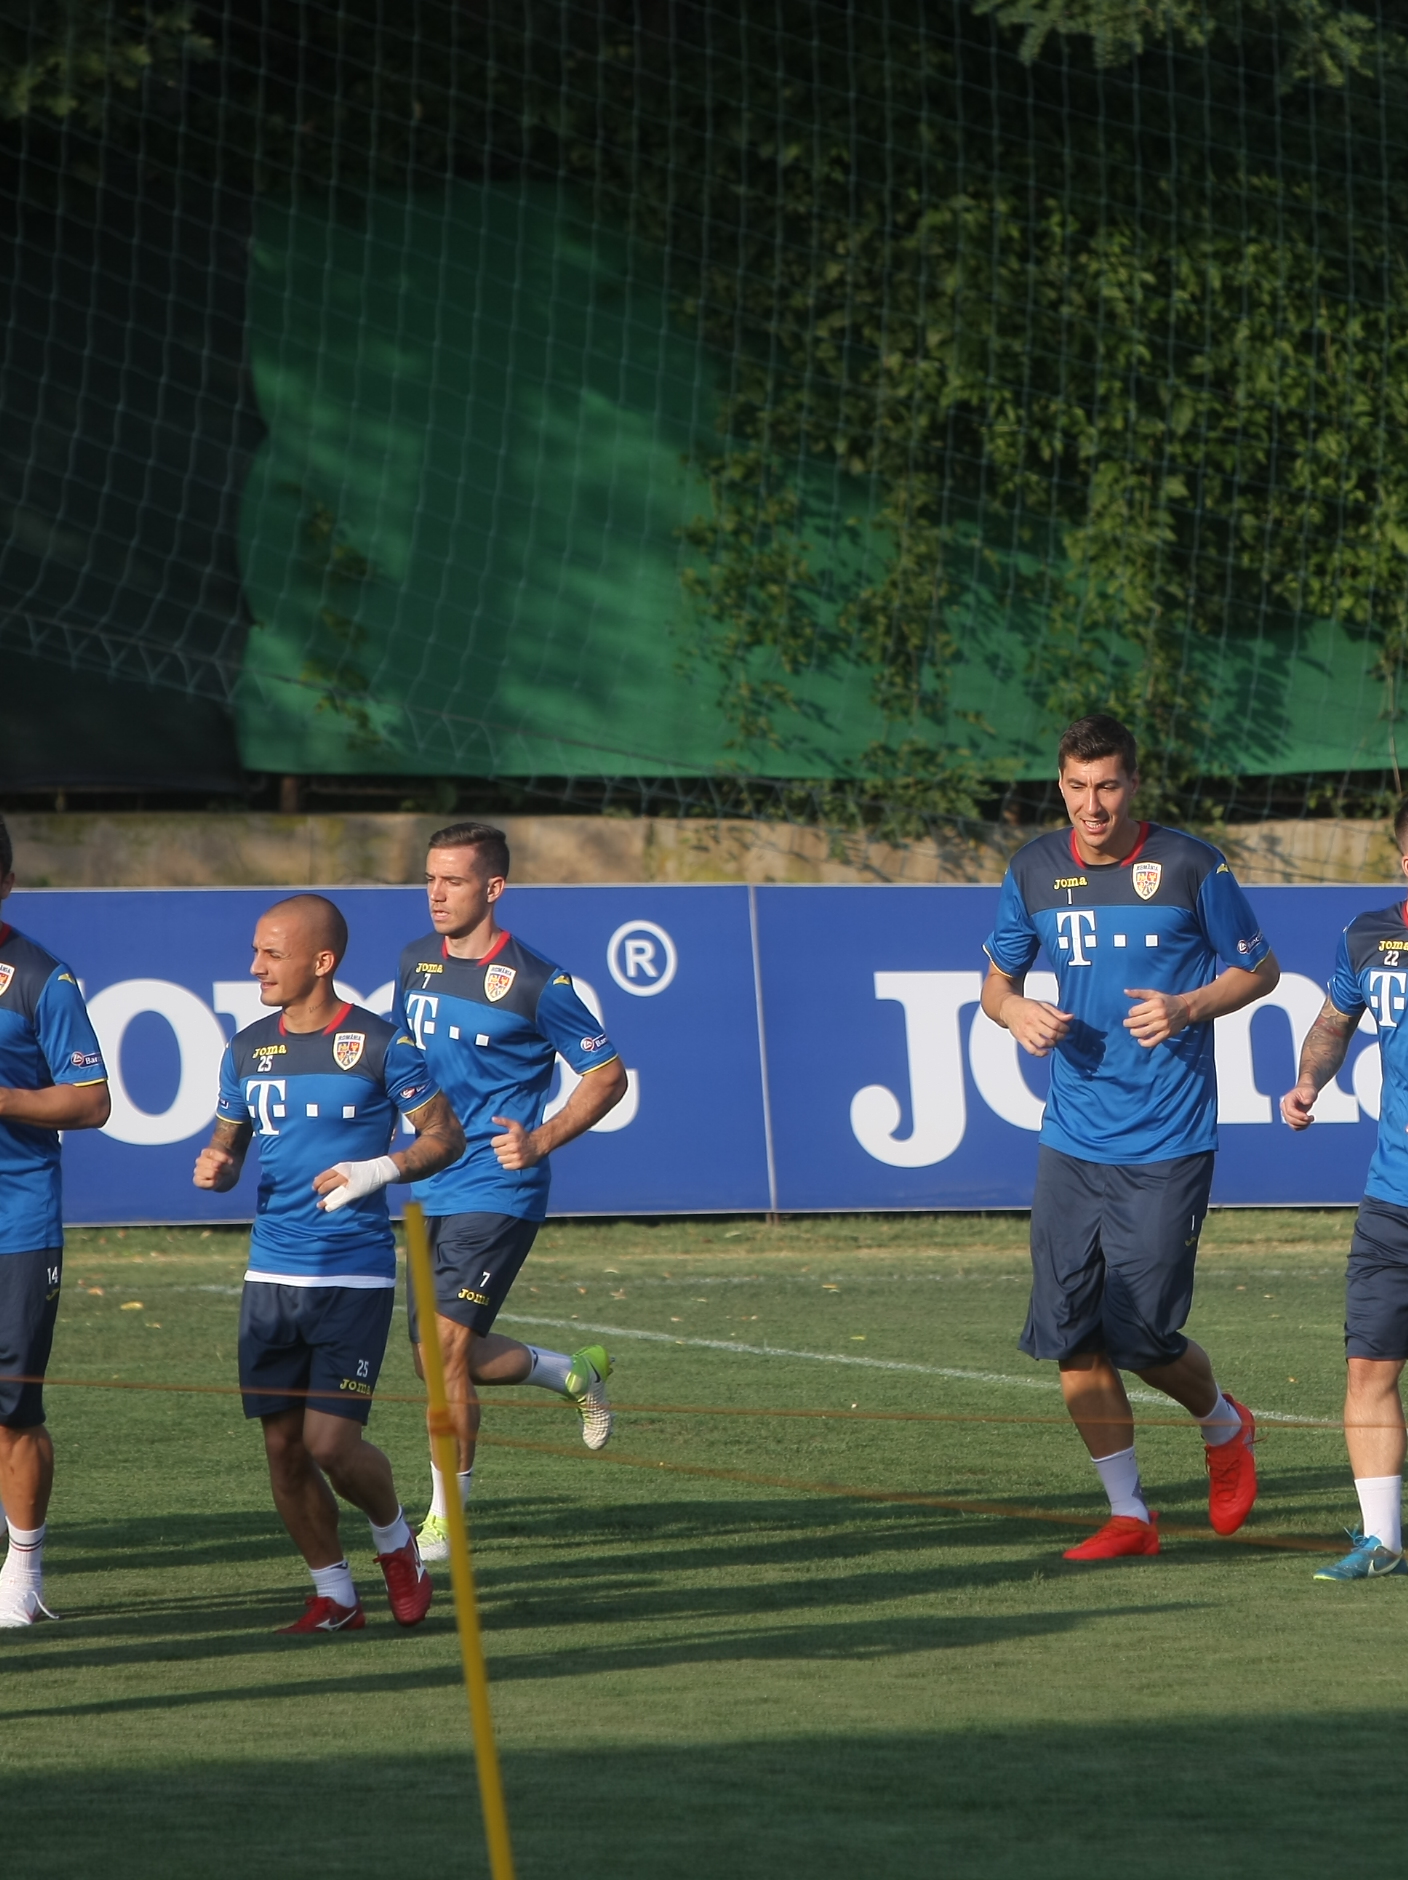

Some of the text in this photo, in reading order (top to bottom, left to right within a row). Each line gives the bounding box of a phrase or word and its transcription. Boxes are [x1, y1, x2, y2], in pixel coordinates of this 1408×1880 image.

[1056, 910, 1097, 966] T
[1383, 950, 1399, 967] 22
[422, 973, 430, 989] 7
[1369, 971, 1407, 1028] T
[257, 1056, 273, 1072] 25
[247, 1080, 286, 1136] T
[47, 1266, 59, 1284] 14
[479, 1271, 491, 1288] 7
[356, 1359, 369, 1378] 25
